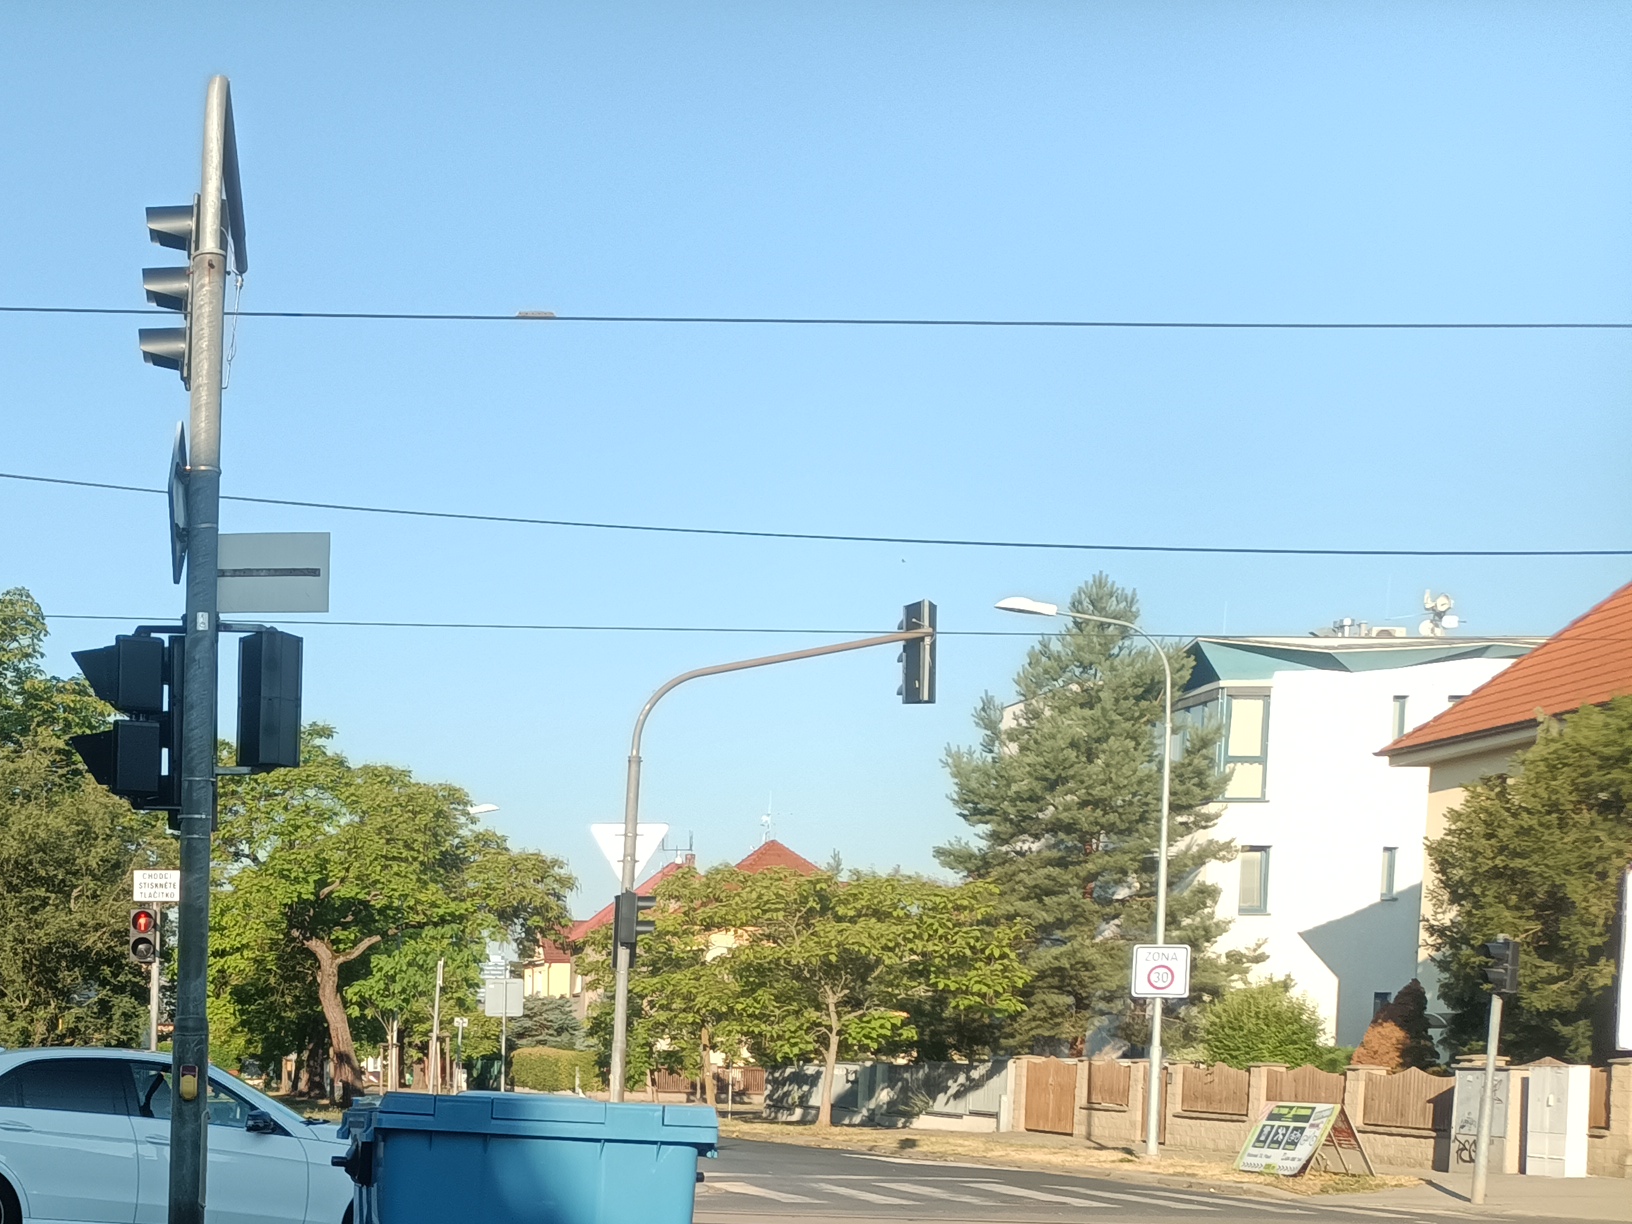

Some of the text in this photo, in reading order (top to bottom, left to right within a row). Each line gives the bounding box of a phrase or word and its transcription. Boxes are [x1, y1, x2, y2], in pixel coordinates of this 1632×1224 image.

[142, 872, 172, 880] CHODCI
[1145, 951, 1178, 962] ZONA
[1153, 971, 1169, 983] 30
